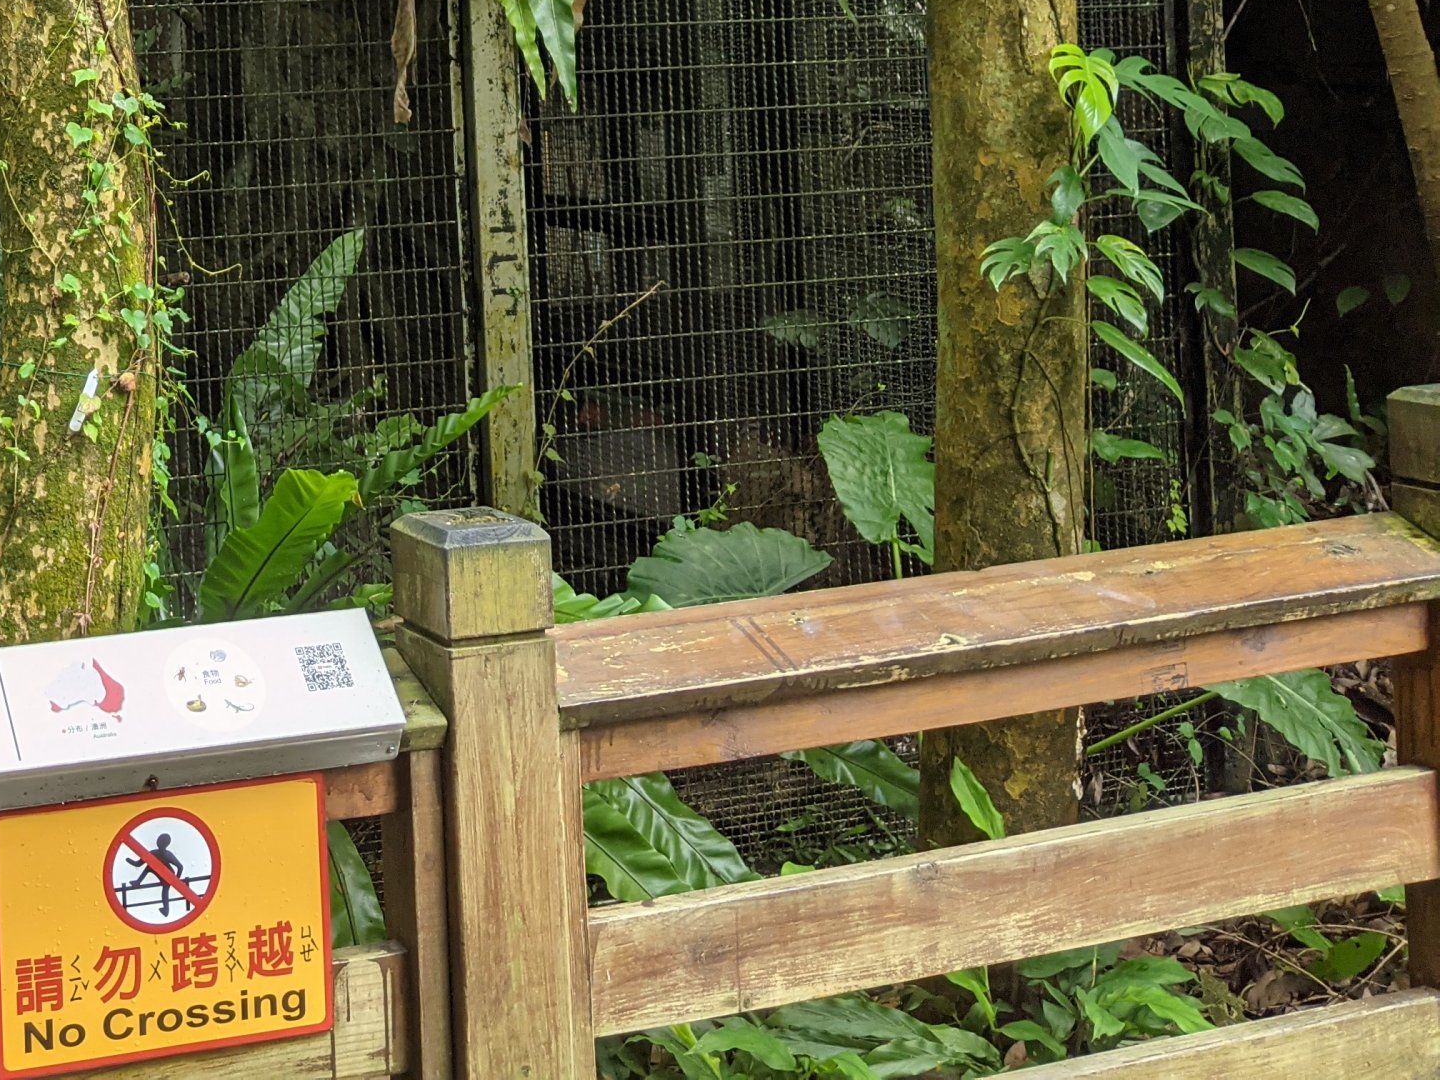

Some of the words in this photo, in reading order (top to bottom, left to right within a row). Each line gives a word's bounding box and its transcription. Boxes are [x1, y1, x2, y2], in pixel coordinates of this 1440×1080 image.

[203, 669, 220, 678] 食物
[16, 920, 294, 1016] 請勿跨越
[24, 1019, 86, 1053] No
[103, 988, 307, 1041] Crossing
